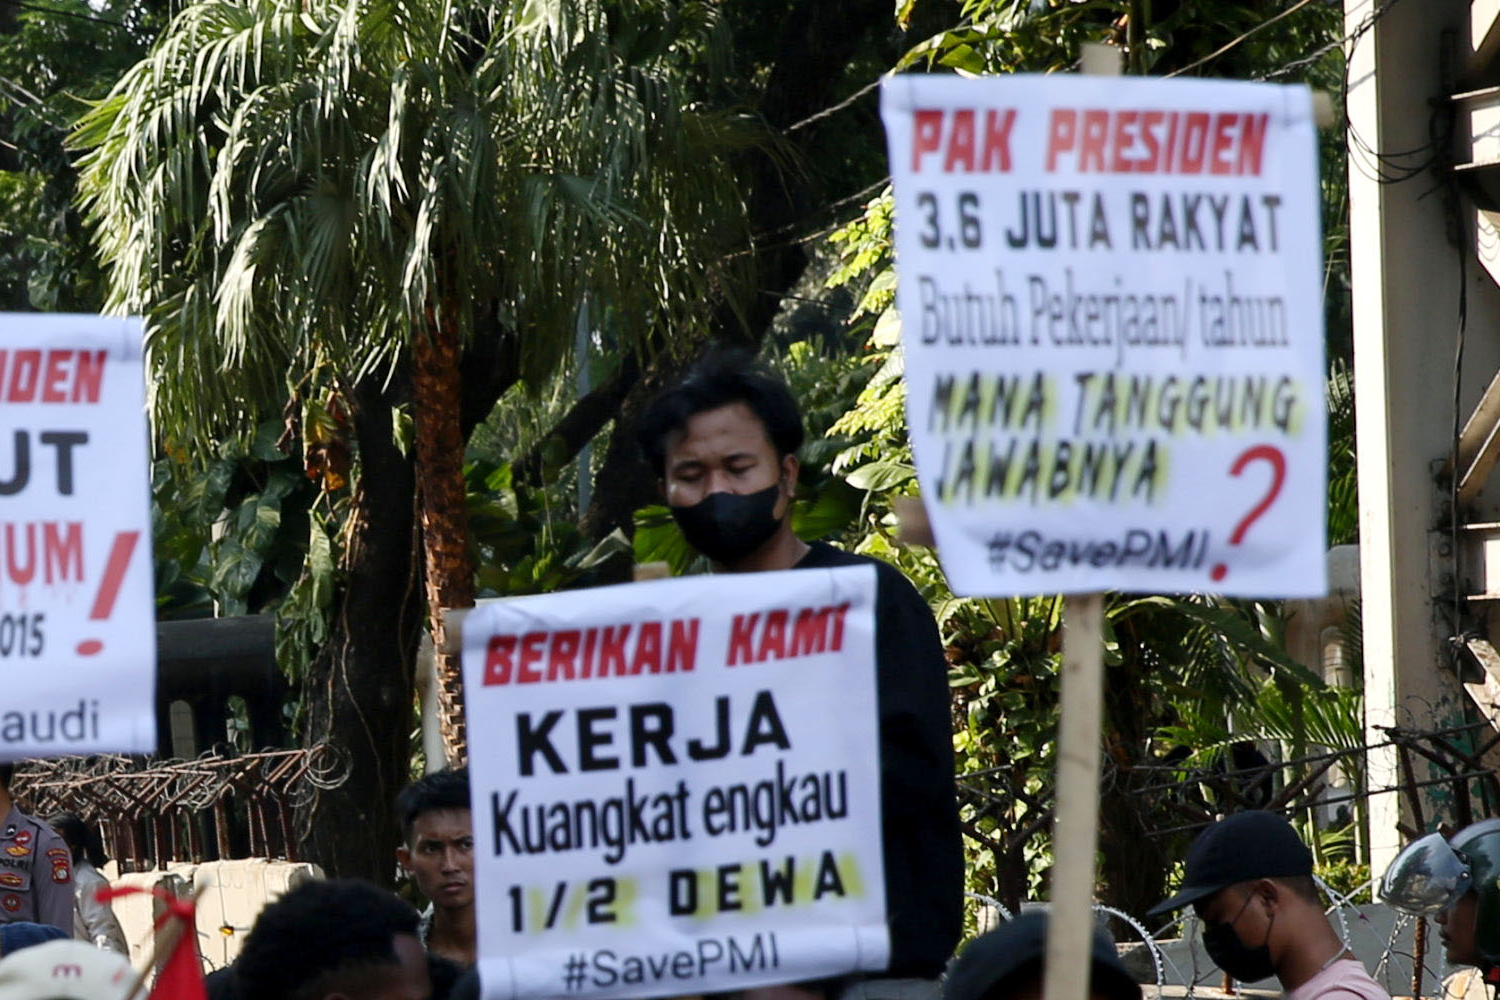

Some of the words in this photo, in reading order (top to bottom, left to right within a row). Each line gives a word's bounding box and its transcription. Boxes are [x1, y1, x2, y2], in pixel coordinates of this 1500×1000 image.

[910, 109, 1017, 174] PAK
[1045, 109, 1270, 176] PRESIDEN
[917, 192, 984, 250] 3.6
[1005, 191, 1111, 250] JUTA
[1130, 193, 1283, 252] RAKYAT
[918, 270, 1020, 348] Butuh
[928, 370, 1050, 441] MANA
[1072, 370, 1298, 440] TANGGUNG
[934, 437, 1161, 507] JAWABNYA
[1208, 444, 1287, 583] ?
[986, 530, 1210, 574] #SavePMI
[76, 530, 140, 656] !
[482, 617, 700, 687] BERIKAN
[515, 690, 791, 777] KERJA
[491, 775, 691, 865] Kuangkat
[702, 760, 848, 848] engkau
[508, 876, 619, 933] 1/2
[669, 851, 847, 916] DEWA
[563, 932, 781, 992] #SavePMI
